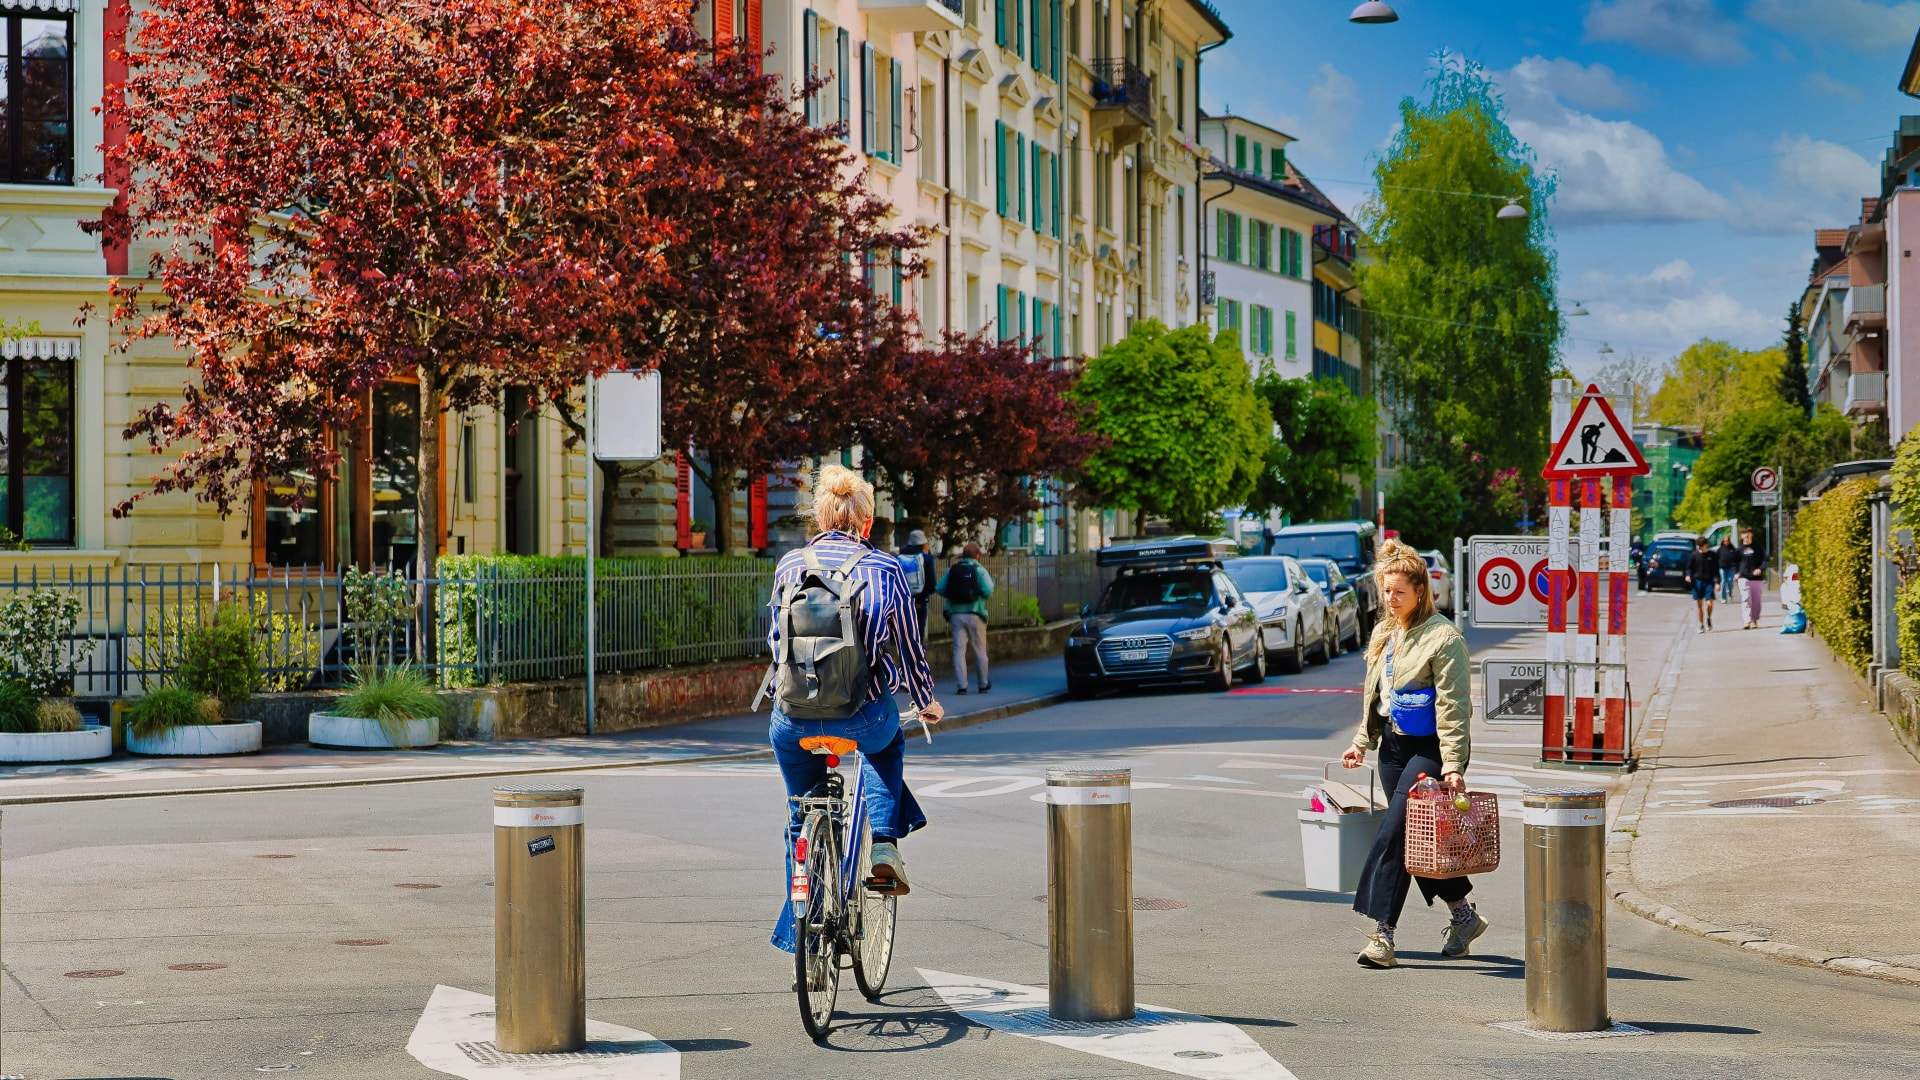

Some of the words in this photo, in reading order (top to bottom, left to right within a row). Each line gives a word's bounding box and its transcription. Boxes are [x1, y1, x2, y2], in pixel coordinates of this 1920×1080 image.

[1512, 544, 1542, 555] ZONE
[1491, 572, 1511, 590] 30
[1511, 666, 1543, 677] ZONE
